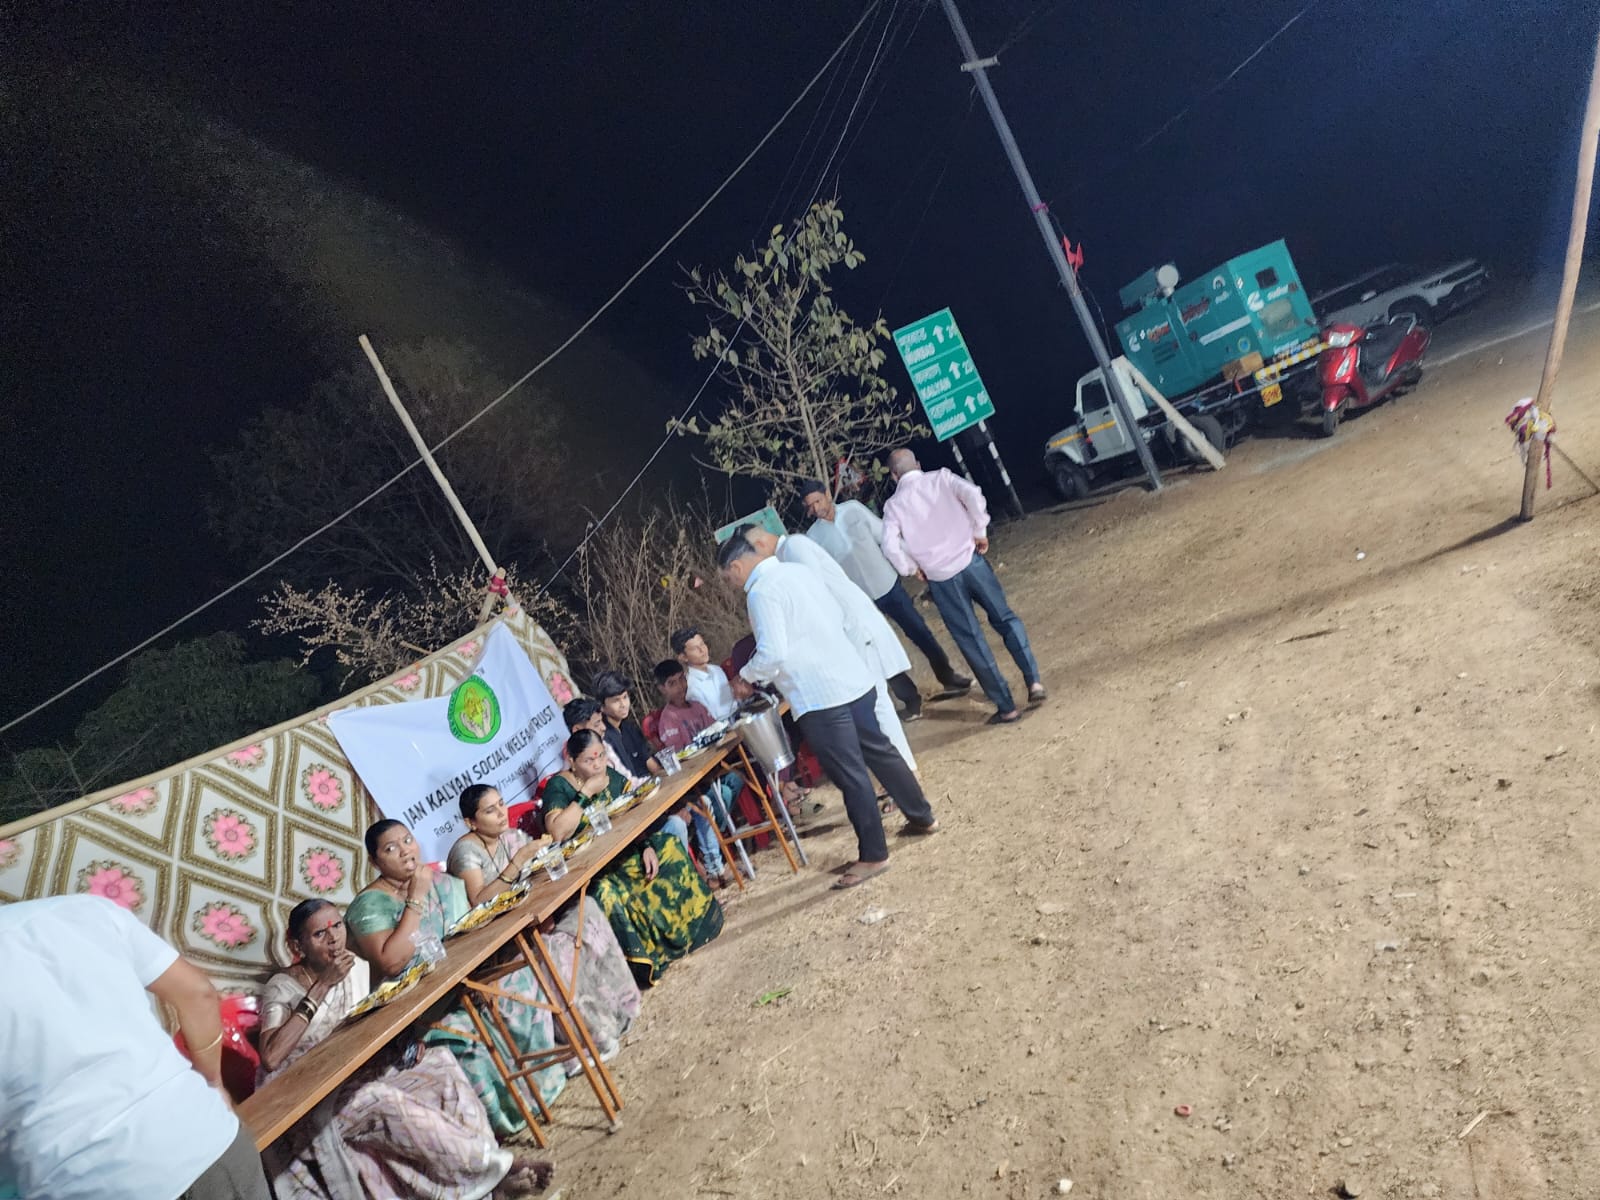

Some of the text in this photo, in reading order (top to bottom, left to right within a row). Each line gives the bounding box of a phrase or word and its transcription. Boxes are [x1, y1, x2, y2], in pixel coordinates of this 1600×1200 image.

[402, 801, 428, 830] JAN
[425, 770, 474, 812] KALYAN
[472, 747, 510, 780] SOCIAL
[505, 724, 535, 756] WELFA
[433, 820, 455, 838] Reg.
[453, 811, 465, 824] N
